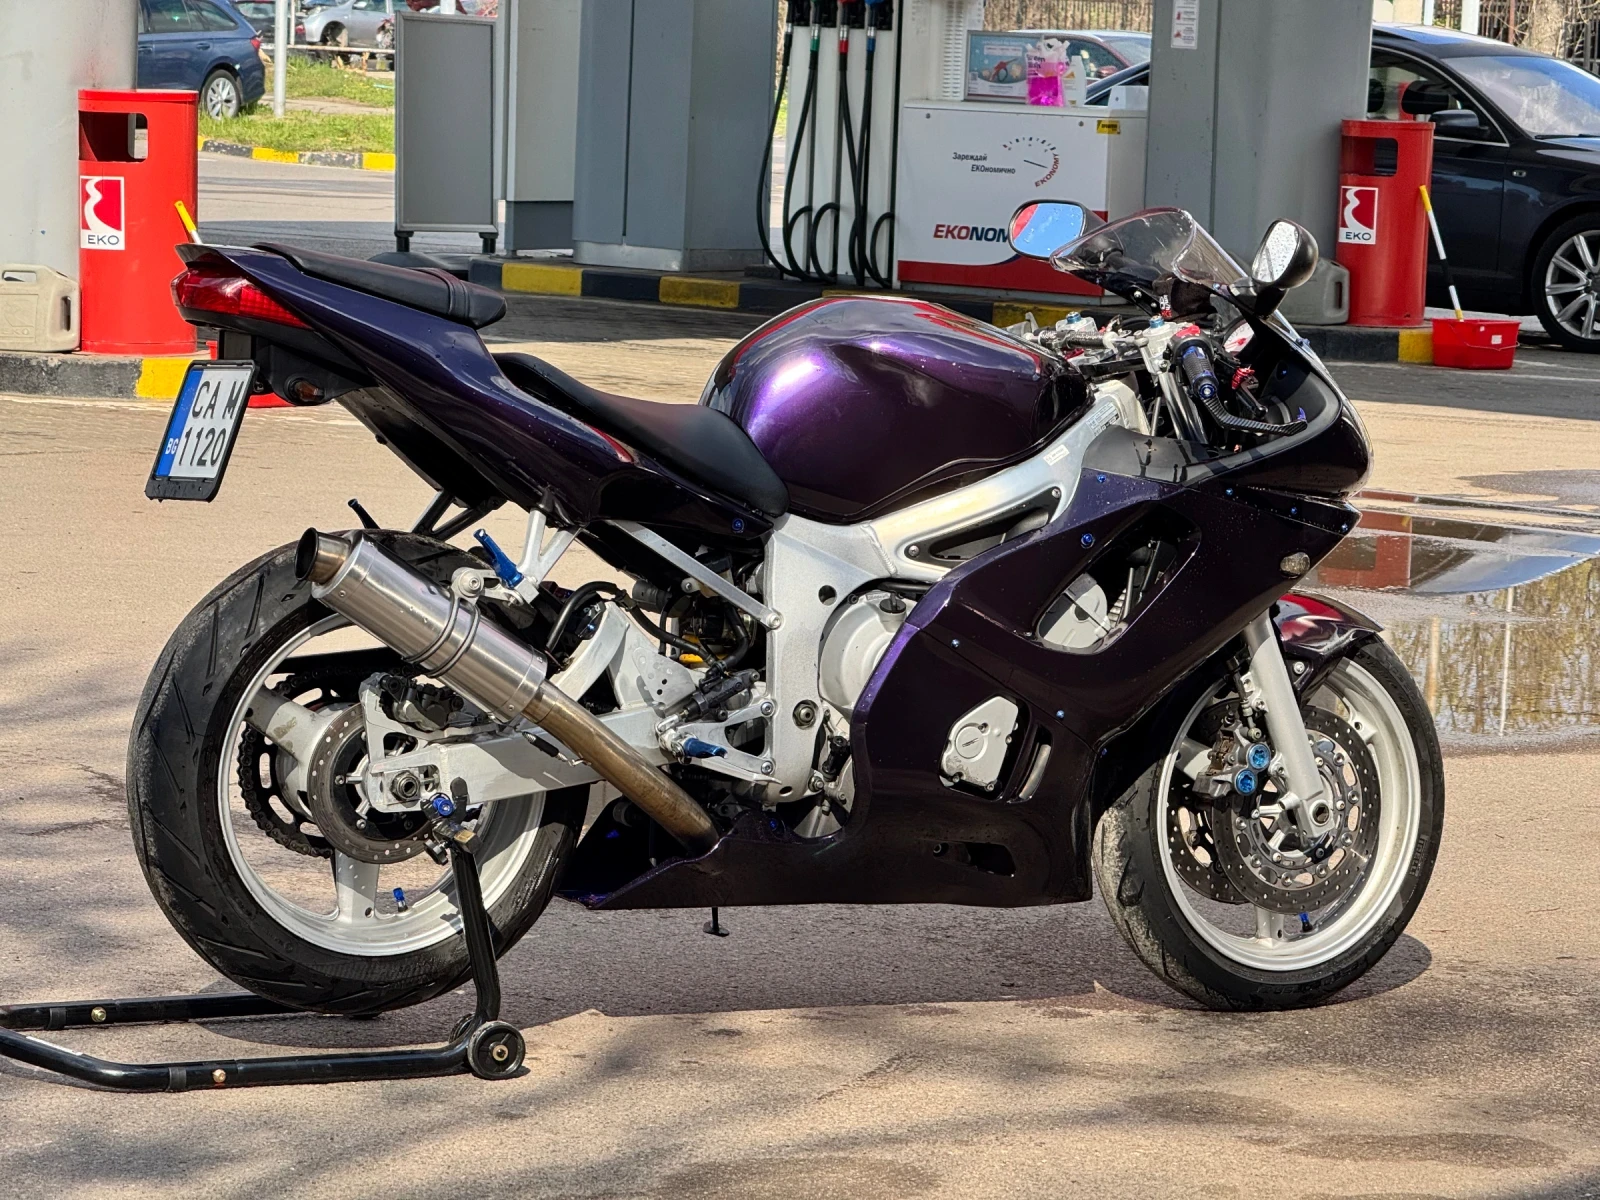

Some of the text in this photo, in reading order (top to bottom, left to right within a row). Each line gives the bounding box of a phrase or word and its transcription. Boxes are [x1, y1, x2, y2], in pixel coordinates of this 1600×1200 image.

[952, 152, 988, 162] Зареждай
[971, 164, 1016, 175] ЕКОномично
[1034, 153, 1060, 188] EKONOMY
[87, 234, 120, 246] EKO
[933, 223, 1009, 243] EKONOM
[1345, 231, 1372, 242] EKO
[191, 380, 245, 420] CA M
[164, 437, 181, 455] BG
[178, 426, 228, 468] 1120
